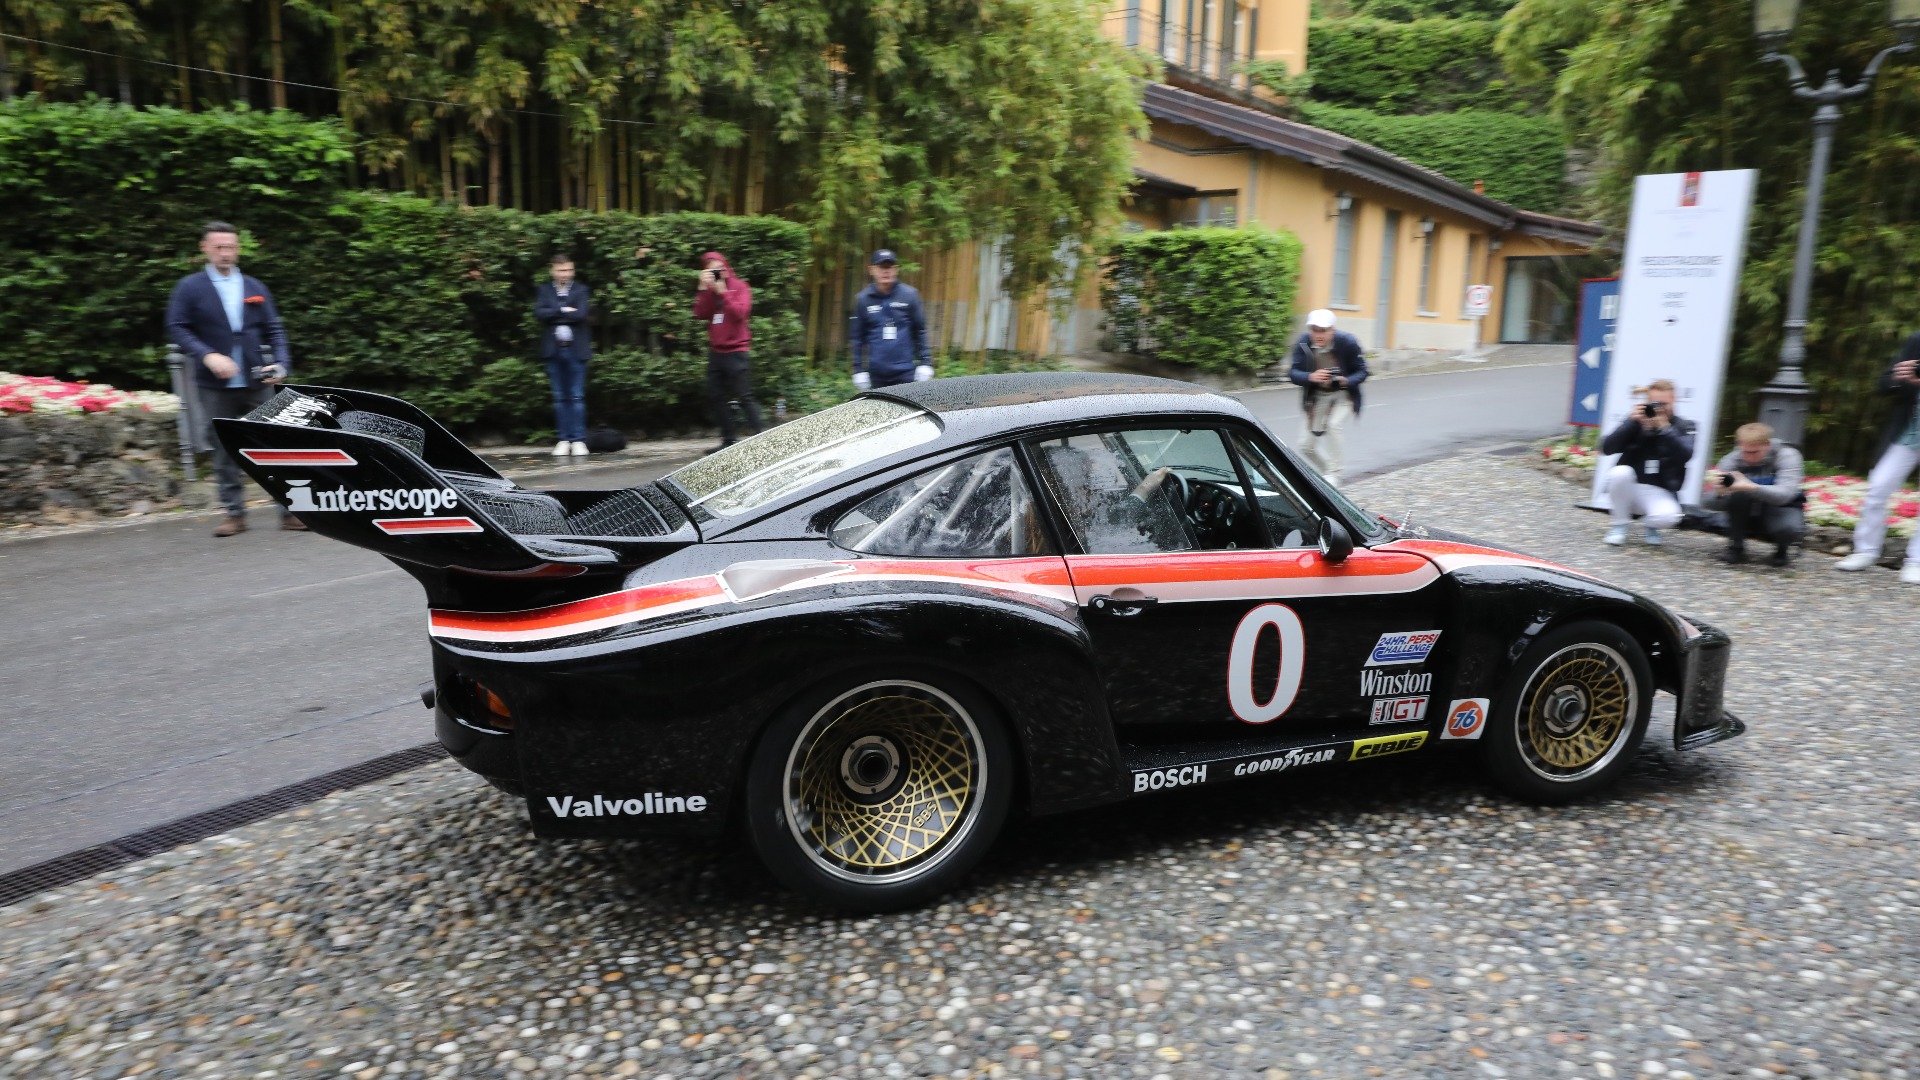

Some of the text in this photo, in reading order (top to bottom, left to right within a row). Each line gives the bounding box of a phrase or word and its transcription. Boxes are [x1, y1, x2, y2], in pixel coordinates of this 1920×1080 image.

[1226, 602, 1306, 725] 0
[1373, 643, 1432, 657] CHALLENGE
[1360, 669, 1433, 697] Winston
[1393, 699, 1425, 720] GT
[1449, 708, 1479, 730] 76
[1133, 764, 1208, 793] BOSCH
[546, 791, 708, 819] Valvoline
[913, 801, 937, 828] BBS
